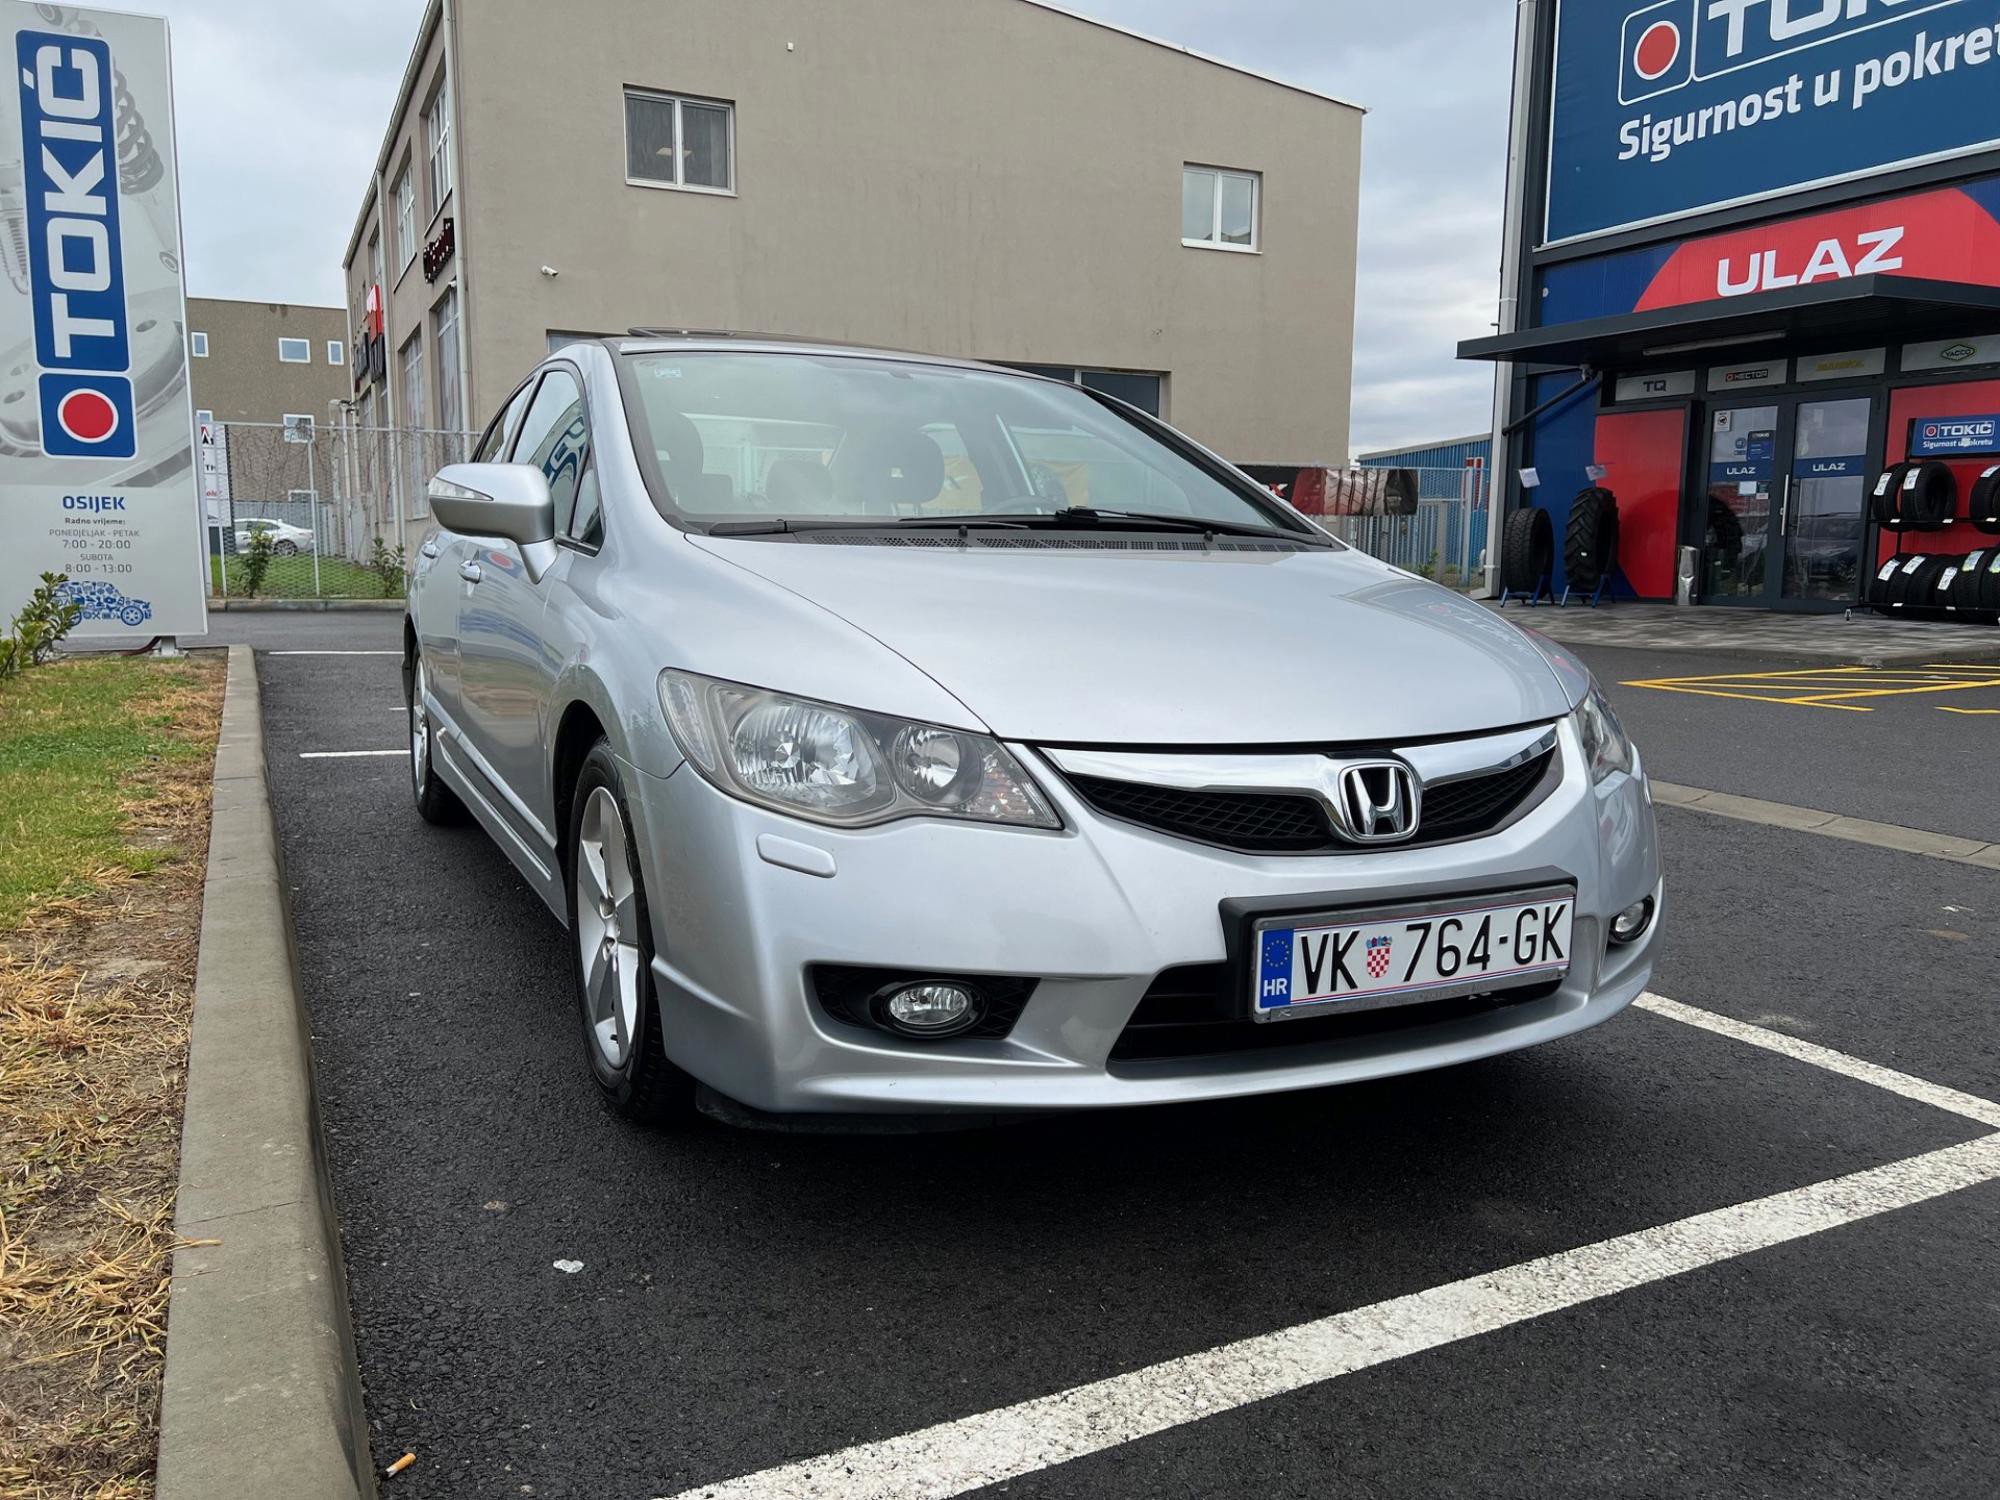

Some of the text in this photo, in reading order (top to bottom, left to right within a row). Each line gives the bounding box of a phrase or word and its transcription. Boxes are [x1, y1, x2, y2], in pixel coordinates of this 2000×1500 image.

[1617, 73, 1803, 161] Sigurnost
[1813, 69, 1841, 107] u
[22, 45, 115, 358] TOKIĆ
[1717, 226, 1904, 298] ULAZ
[1734, 369, 1769, 380] HECTOR
[1643, 380, 1666, 393] TQ
[1941, 421, 1992, 436] TOKIĆ
[1923, 439, 1957, 450] Sigurnost
[1963, 438, 1993, 448] okretu
[1726, 466, 1757, 475] ULAZ
[1813, 462, 1846, 472] ULAZ
[62, 495, 126, 513] OSIJEK
[64, 517, 126, 526] Radno vrijeme:
[49, 528, 106, 538] PONEDJELJAK
[113, 529, 140, 537] PETAK
[62, 539, 87, 549] 7:00
[98, 539, 131, 549] 20:00
[80, 553, 114, 561] SUBOTA
[65, 563, 91, 573] 8:00
[103, 563, 132, 574] 13:00
[1300, 903, 1567, 995] VK 764-GK
[1263, 977, 1288, 998] HR
